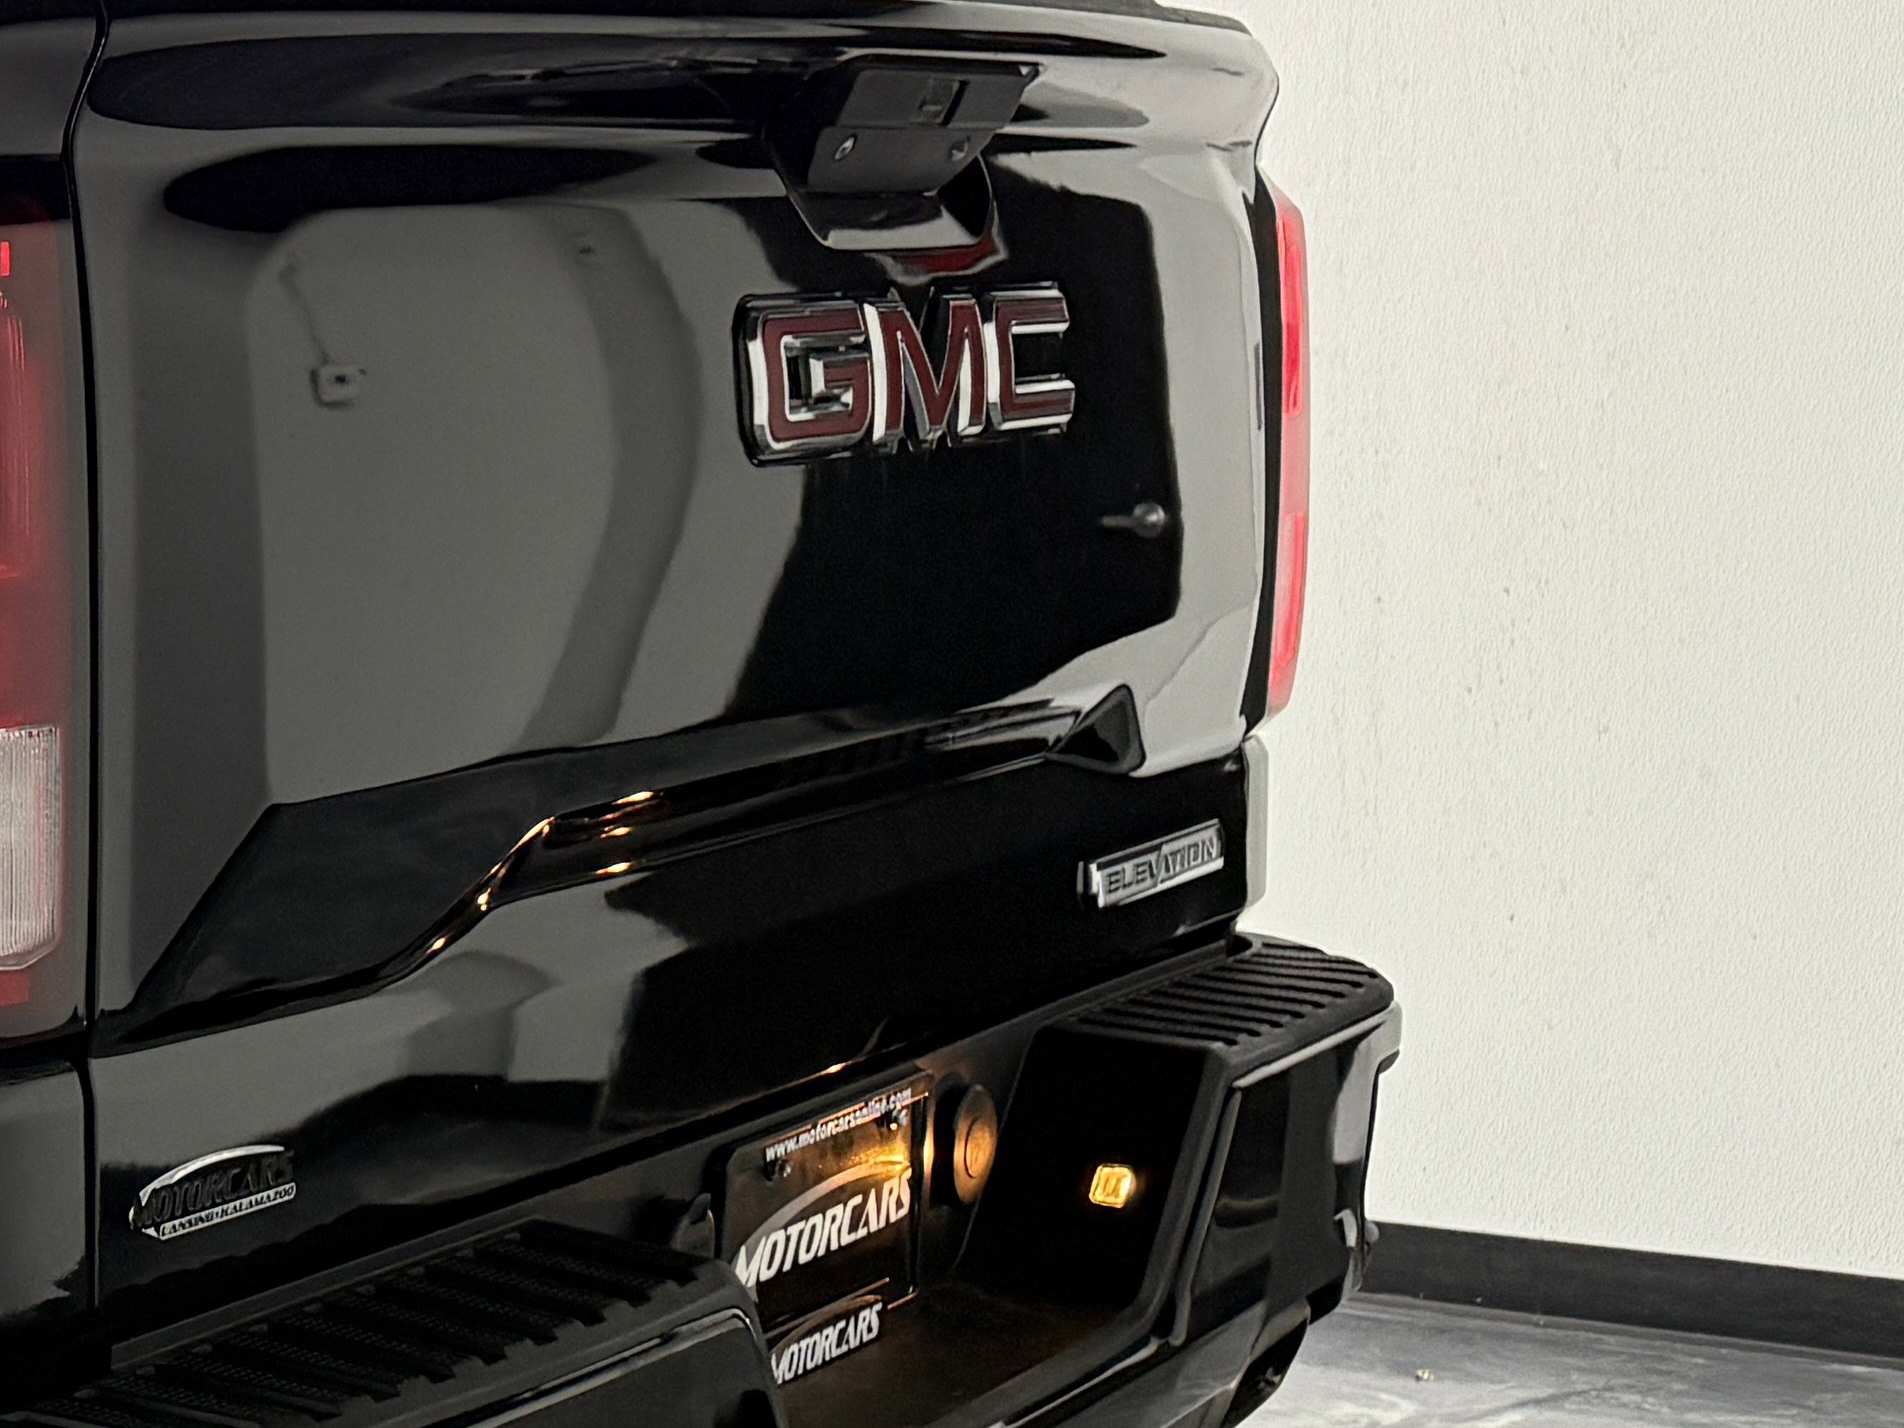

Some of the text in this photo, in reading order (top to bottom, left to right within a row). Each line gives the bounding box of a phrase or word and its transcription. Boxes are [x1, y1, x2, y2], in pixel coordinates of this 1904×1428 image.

[733, 280, 1076, 468] GMC
[1106, 836, 1219, 894] ELEVATION
[735, 1168, 912, 1289] MOTORCARS
[771, 1303, 882, 1384] MOTORCARS
